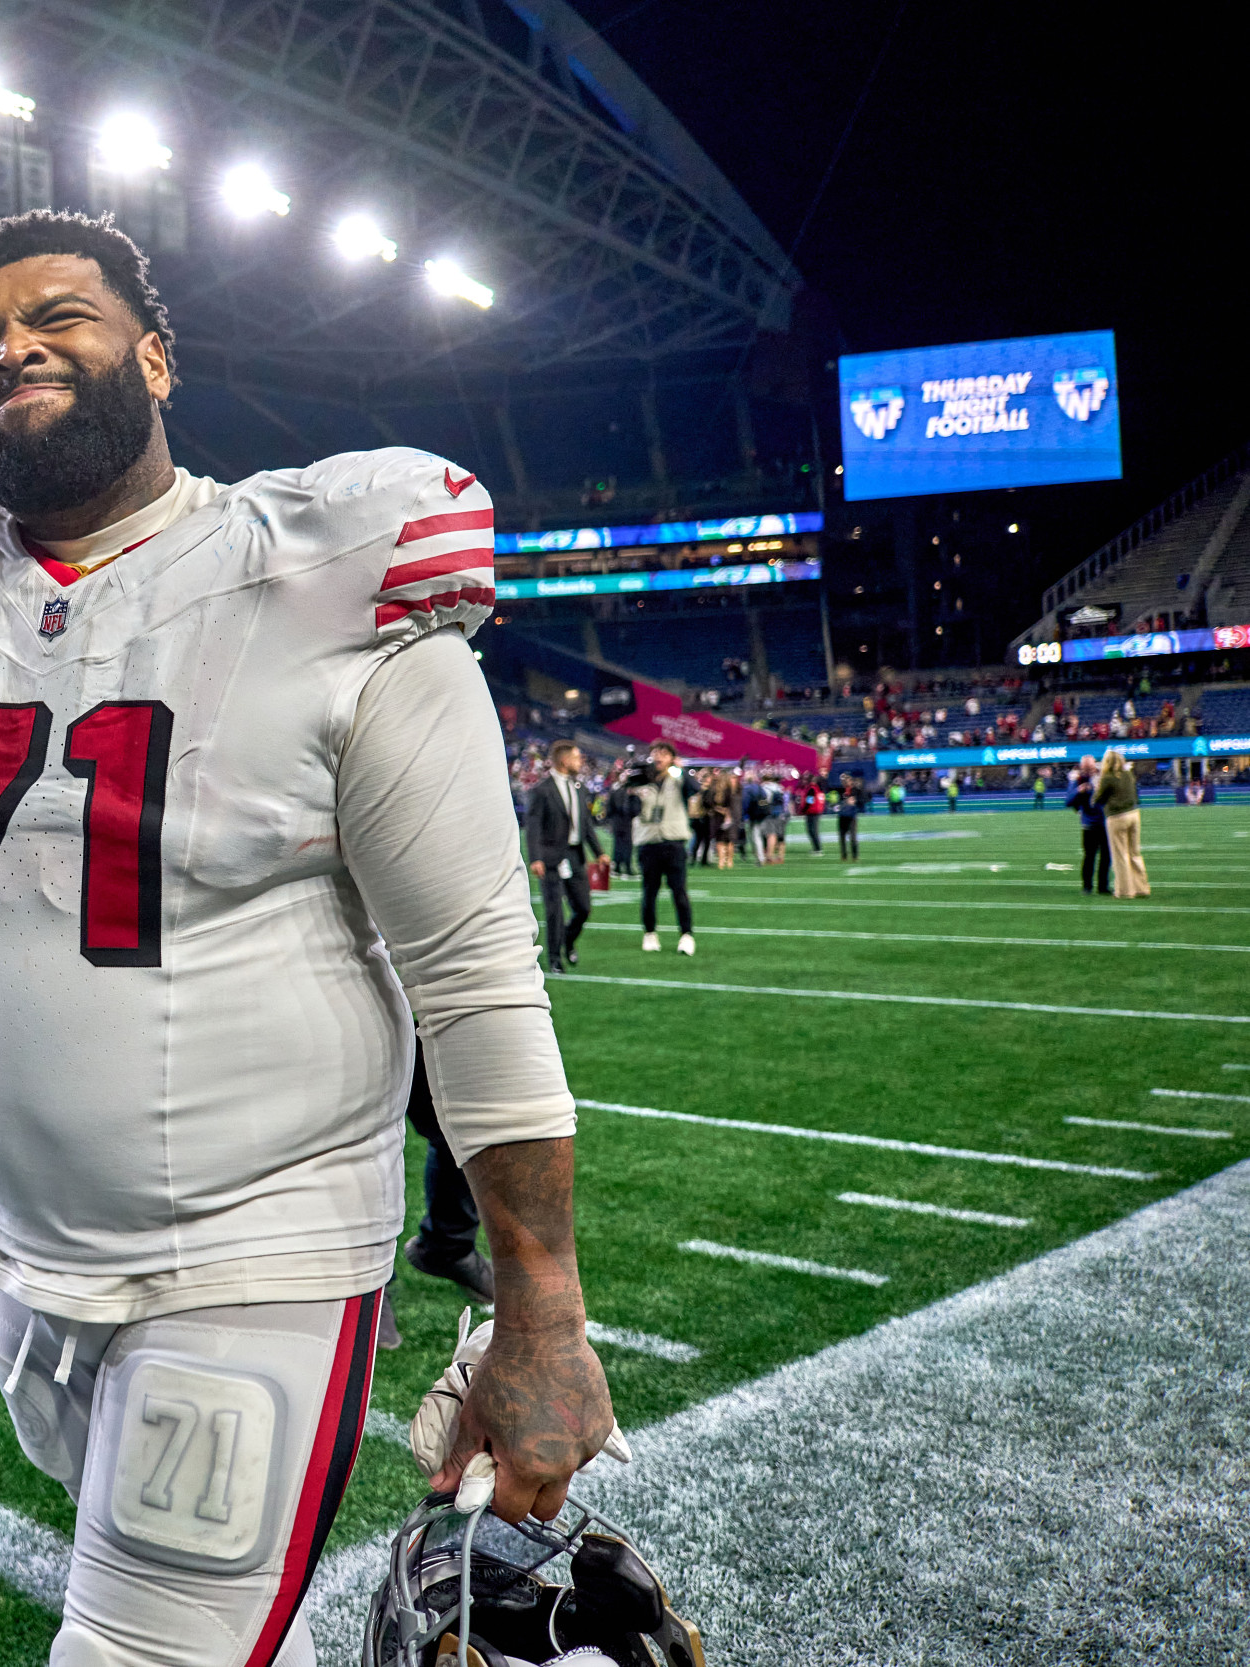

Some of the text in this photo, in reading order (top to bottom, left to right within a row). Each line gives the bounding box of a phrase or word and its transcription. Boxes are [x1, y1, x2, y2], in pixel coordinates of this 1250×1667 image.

[921, 371, 1033, 403] THURSDAY
[942, 394, 1010, 418] NIGHT
[925, 408, 1030, 438] FOOTBALL
[42, 614, 63, 632] NFL
[1018, 642, 1062, 665] 0:00
[140, 1393, 242, 1525] 71
